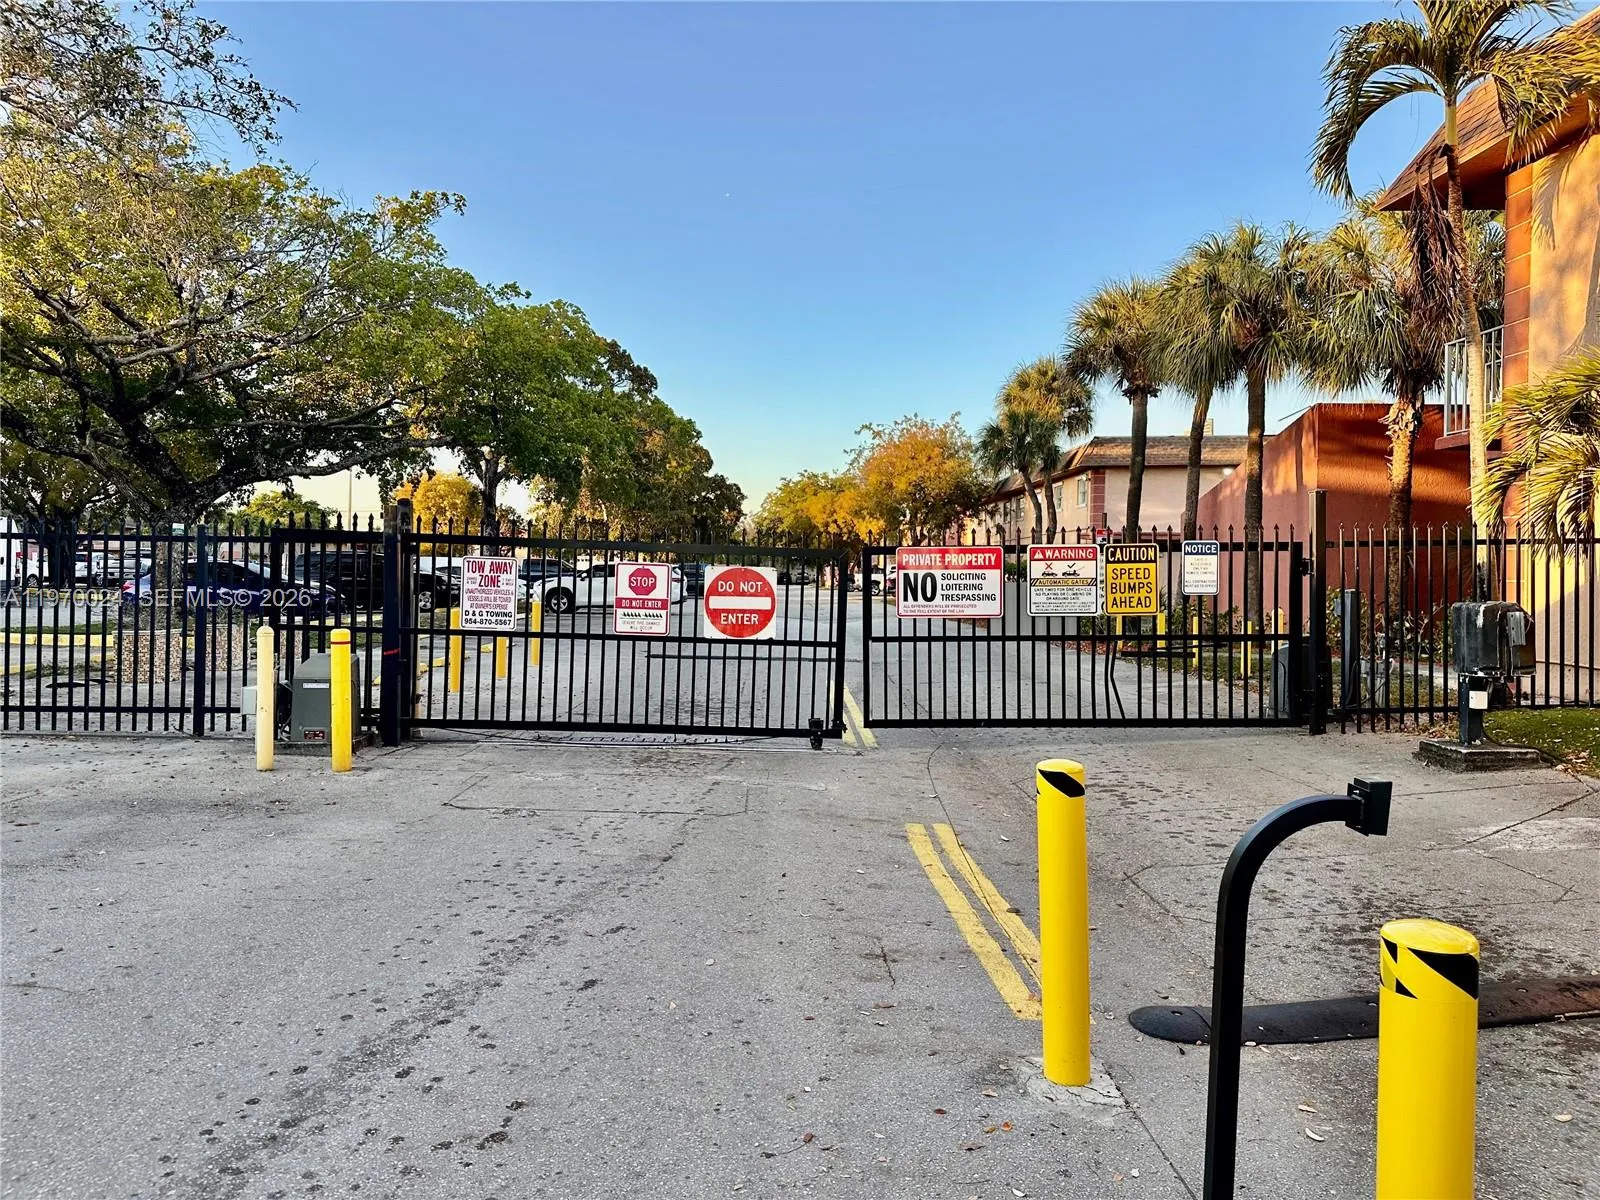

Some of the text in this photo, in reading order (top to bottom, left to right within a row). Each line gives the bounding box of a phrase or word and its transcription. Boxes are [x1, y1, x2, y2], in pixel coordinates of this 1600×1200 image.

[1045, 549, 1093, 558] WARNING
[1108, 548, 1154, 561] CAUTION
[1185, 545, 1216, 553] NOTICE
[902, 553, 996, 566] PRIVATE PROPERTY
[466, 560, 513, 574] TOW AWAY
[1112, 568, 1150, 580] SPEED
[479, 575, 500, 587] ZONE
[631, 577, 655, 587] STOP
[718, 581, 762, 592] DO NOT
[903, 572, 937, 602] NO
[1111, 582, 1152, 594] BUMPS
[1111, 596, 1152, 608] AHEAD
[721, 614, 758, 624] ENTER
